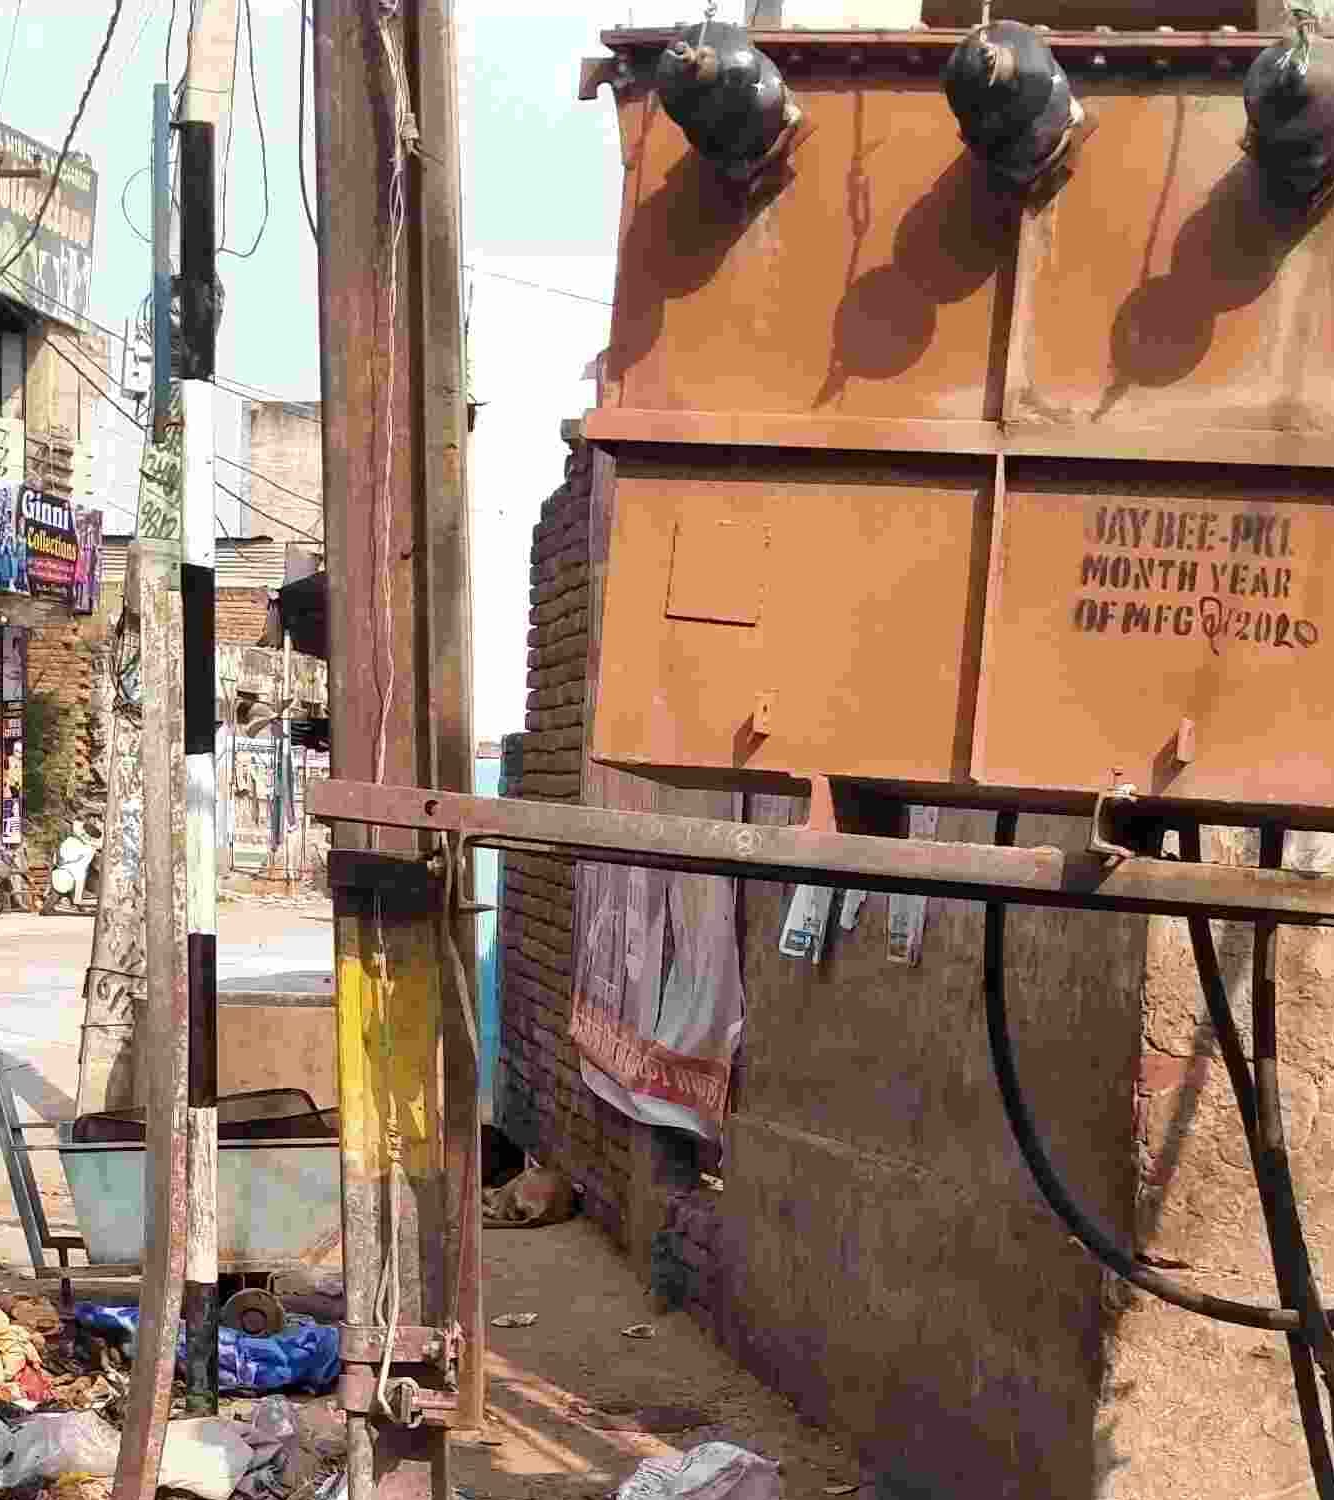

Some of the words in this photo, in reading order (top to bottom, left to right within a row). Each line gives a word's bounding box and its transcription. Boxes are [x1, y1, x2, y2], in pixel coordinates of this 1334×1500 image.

[22, 489, 70, 531] Ginni
[27, 528, 77, 561] Collections
[1079, 552, 1200, 593] MONTH
[1210, 560, 1293, 599] YEAR
[1073, 598, 1119, 633] OF
[1120, 599, 1195, 636] MFG
